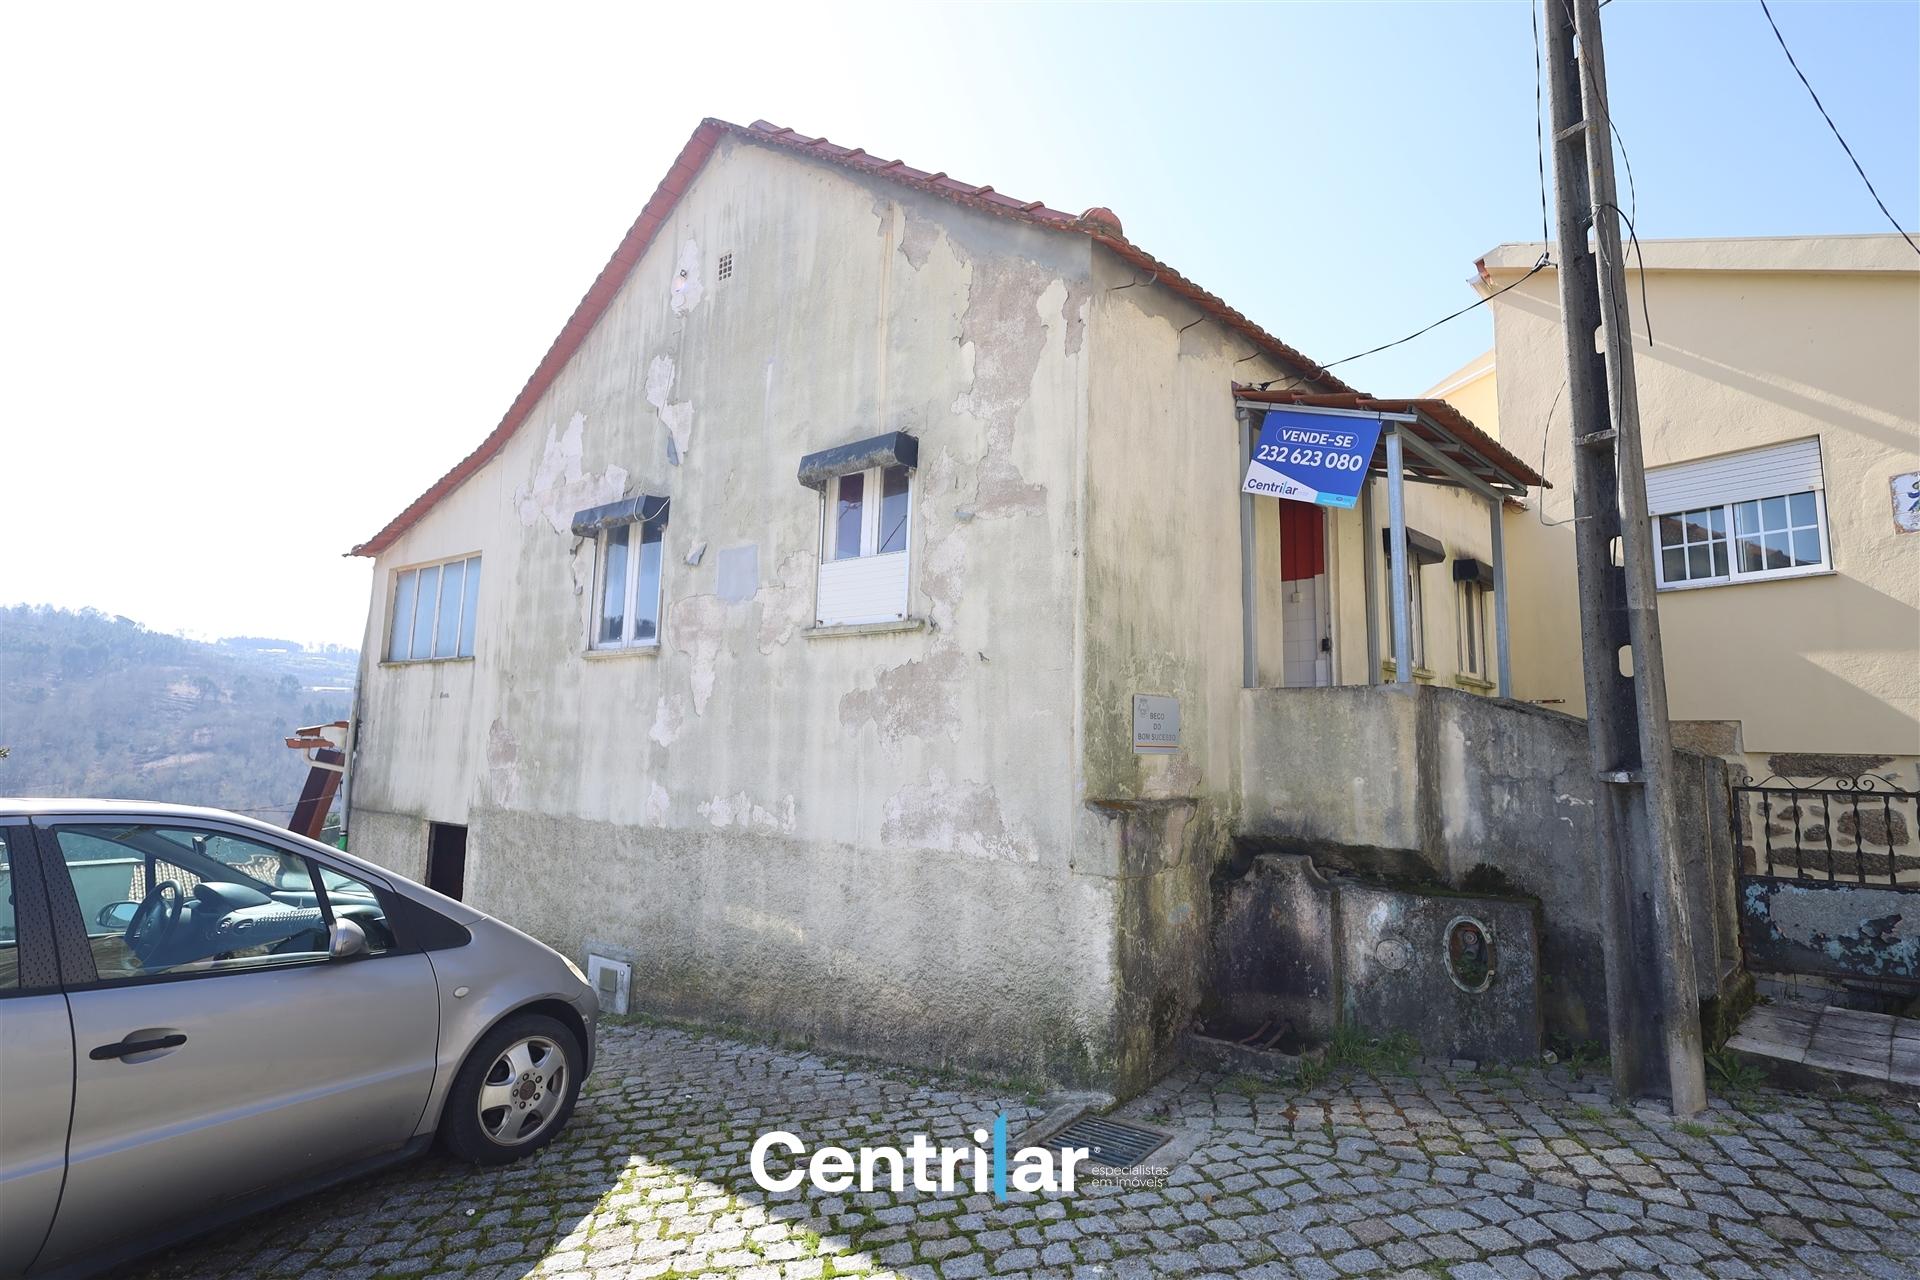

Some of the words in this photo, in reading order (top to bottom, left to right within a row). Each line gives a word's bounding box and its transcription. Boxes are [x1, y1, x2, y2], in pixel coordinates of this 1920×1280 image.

[1282, 429, 1354, 447] VENDE-SE
[1257, 444, 1289, 462] 232
[1290, 448, 1323, 467] 623
[1325, 452, 1363, 472] 080
[1247, 478, 1298, 496] Centrilar
[1149, 712, 1165, 720] BECO
